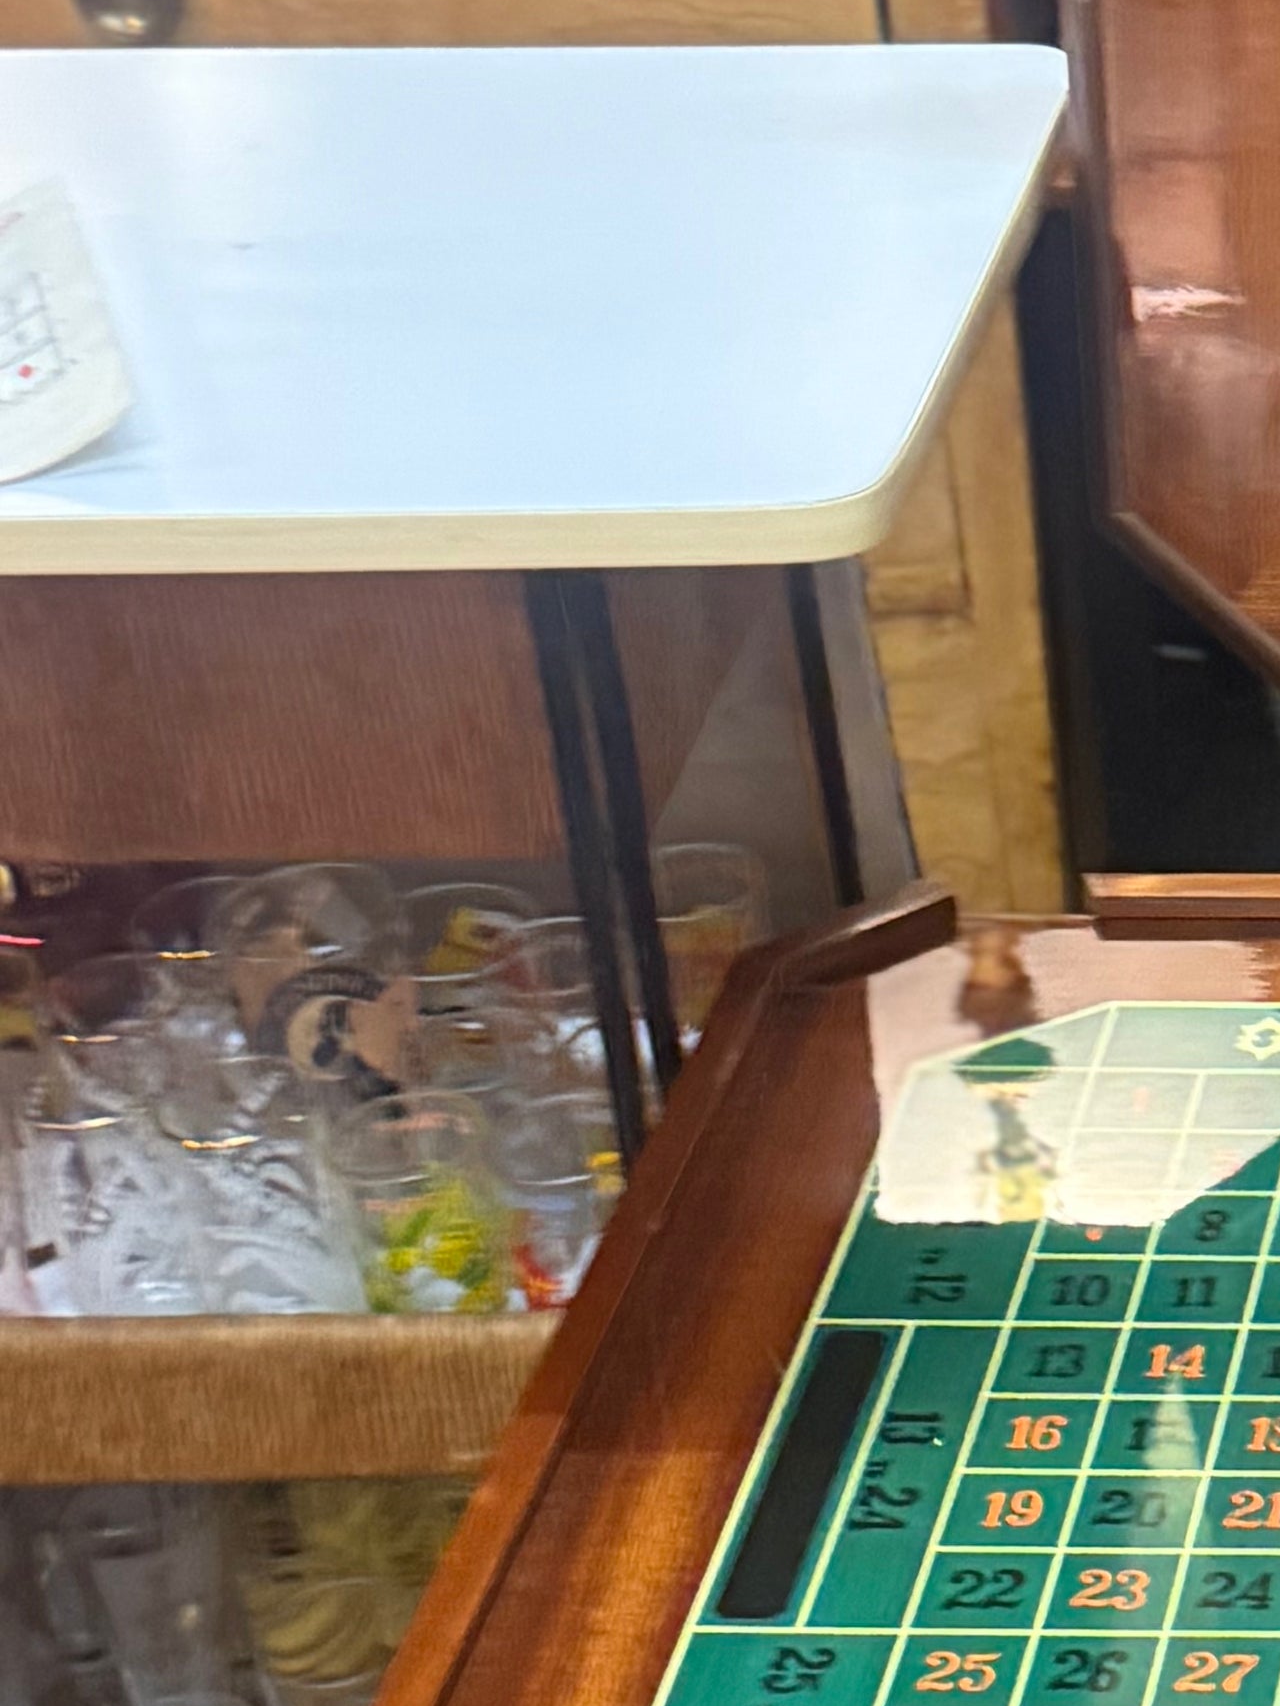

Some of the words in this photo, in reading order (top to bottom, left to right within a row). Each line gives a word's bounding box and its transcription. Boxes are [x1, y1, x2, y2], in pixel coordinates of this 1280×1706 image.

[1194, 1209, 1231, 1243] 8
[1049, 1274, 1111, 1308] 10
[1170, 1275, 1217, 1309] 11
[1027, 1343, 1087, 1379] 13
[1146, 1344, 1204, 1380] 14
[1008, 1415, 1068, 1451] 16
[982, 1490, 1043, 1529] 19
[940, 1568, 1026, 1611] 22
[1069, 1569, 1150, 1611] 23
[1196, 1571, 1274, 1611] 24
[761, 1646, 837, 1695] 25
[915, 1651, 998, 1693] 25
[1044, 1648, 1127, 1693] 26
[1173, 1652, 1259, 1694] 27
